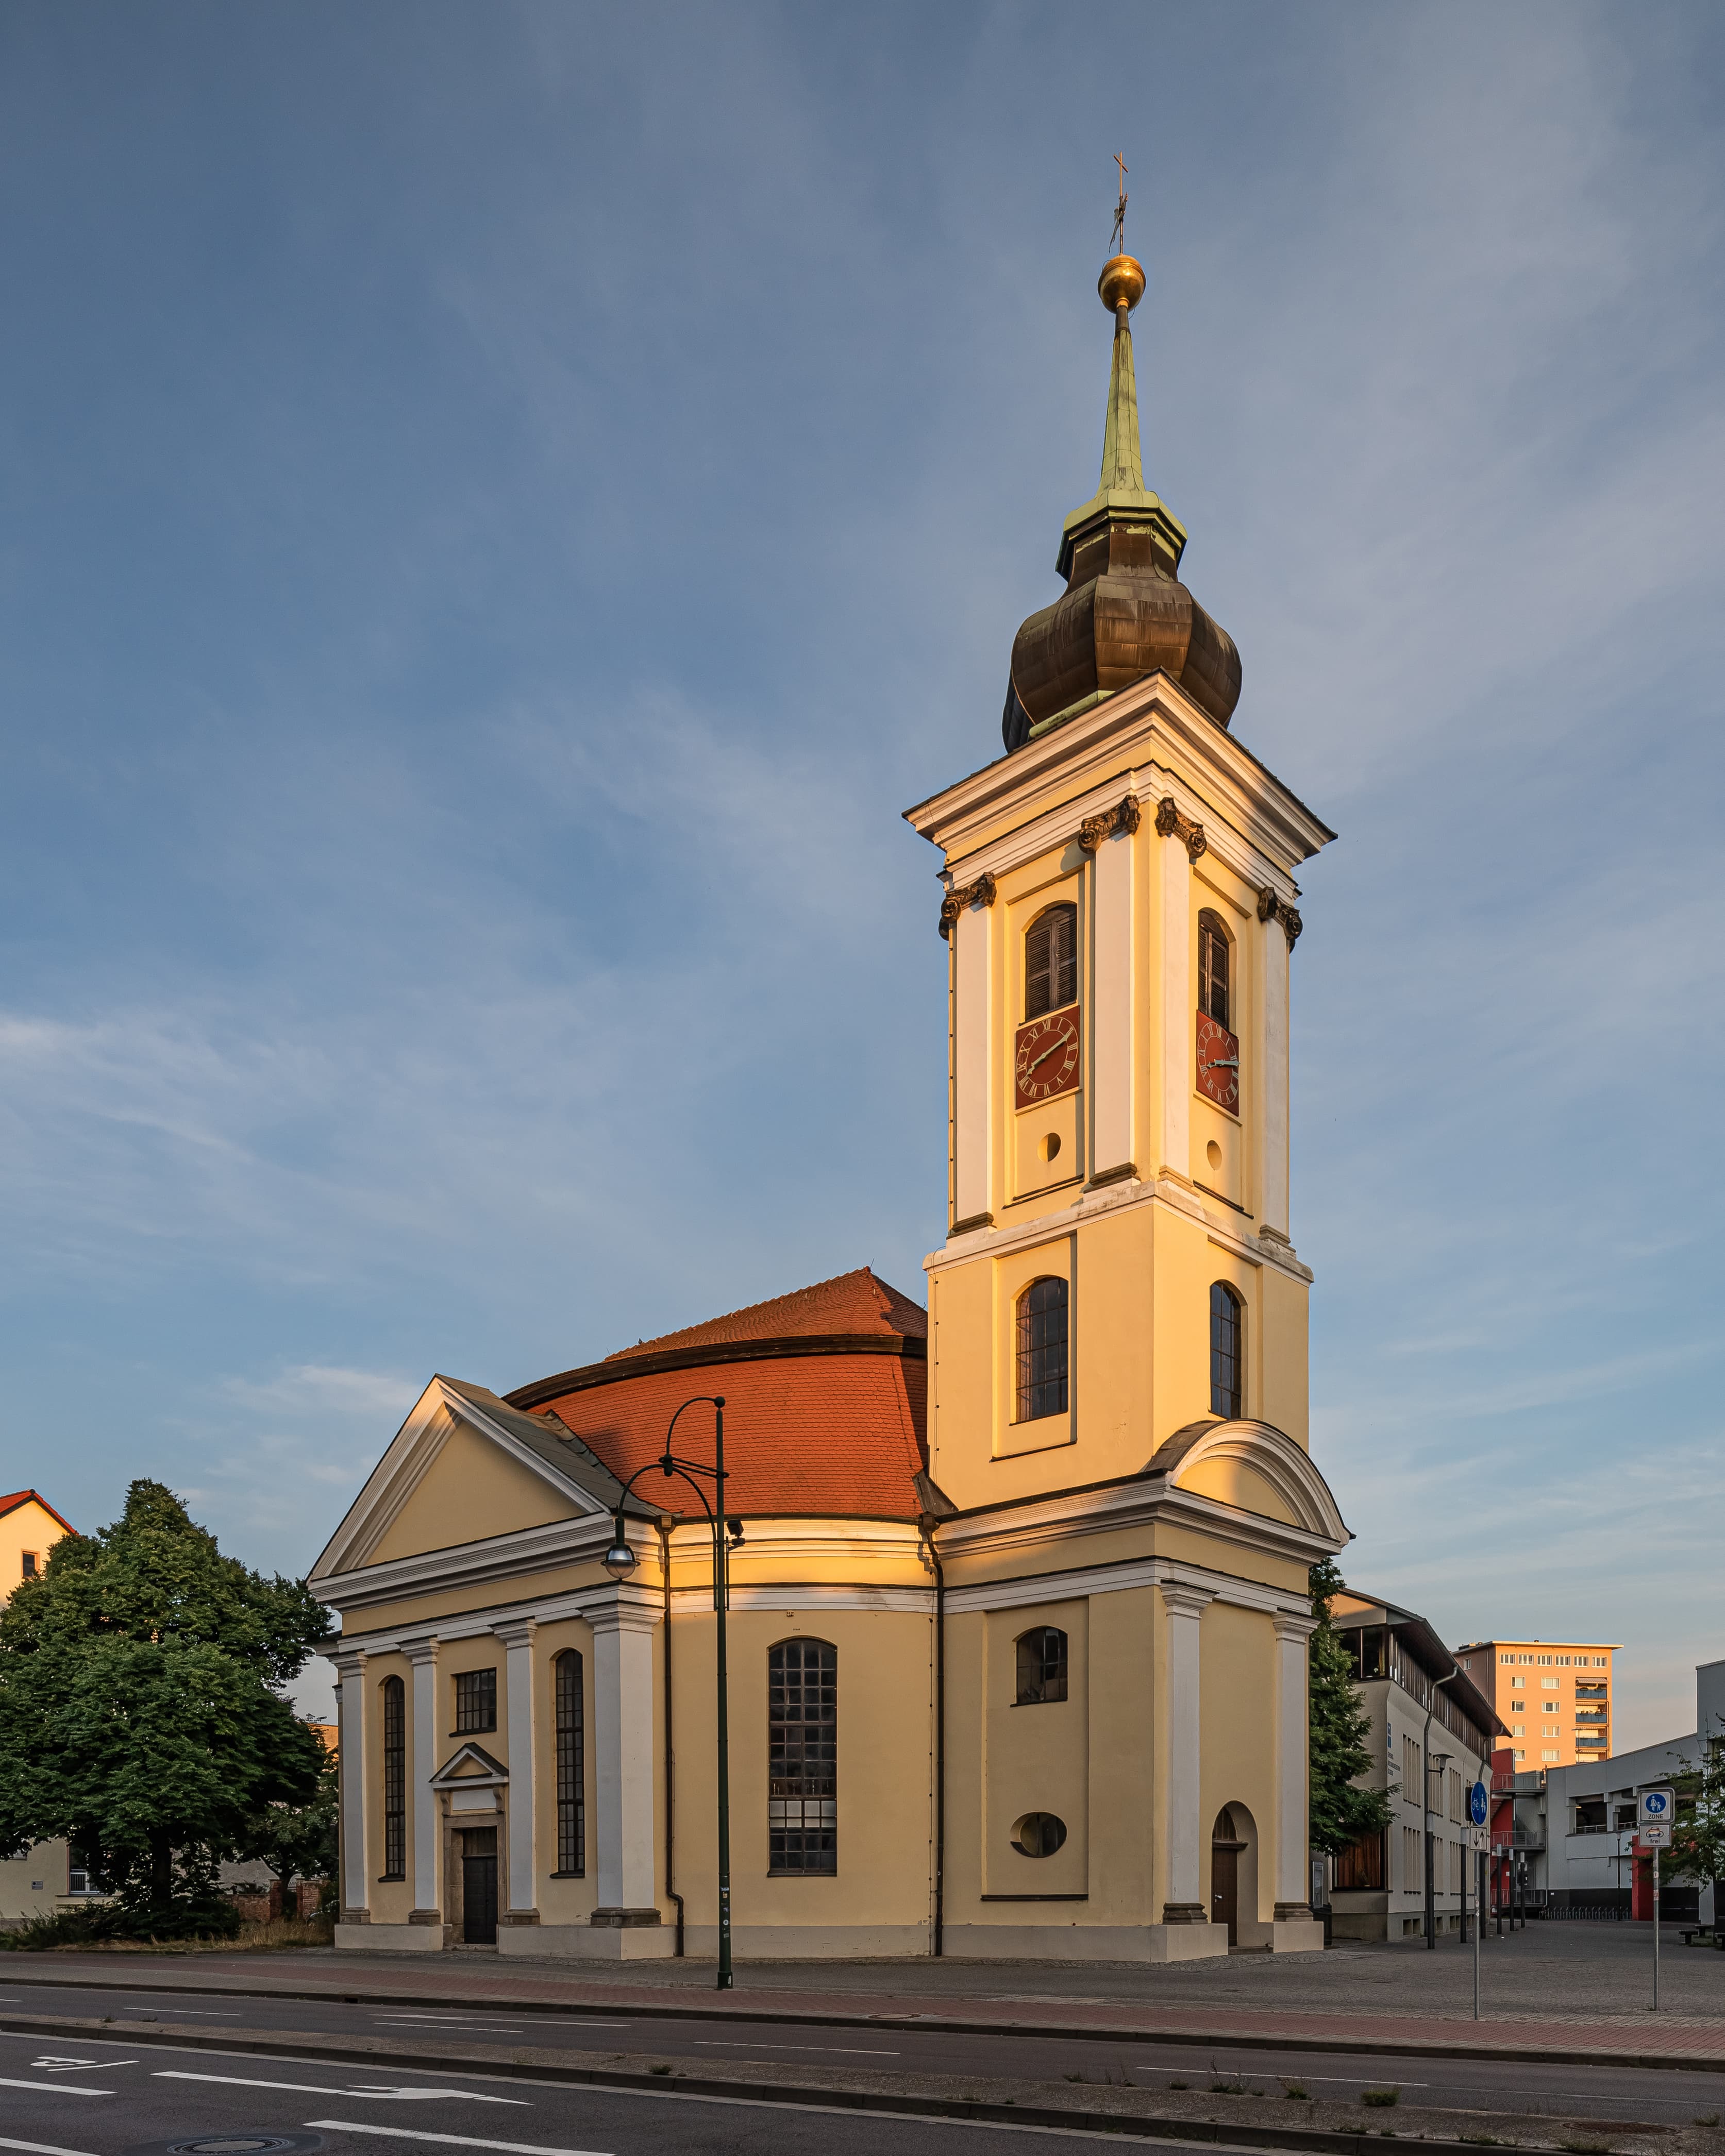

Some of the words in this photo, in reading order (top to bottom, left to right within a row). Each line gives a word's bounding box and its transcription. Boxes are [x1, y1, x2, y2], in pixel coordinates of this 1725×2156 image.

[1042, 1018, 1051, 1032] XII
[1057, 1018, 1063, 1030] I
[1029, 1028, 1039, 1041] XI
[1020, 1044, 1030, 1054] X
[1067, 1042, 1077, 1051] III
[1017, 1062, 1027, 1072] IX
[1064, 1060, 1075, 1071] IIII
[1057, 1077, 1063, 1086] V
[1029, 1084, 1037, 1097] VII
[1044, 1084, 1050, 1096] VI
